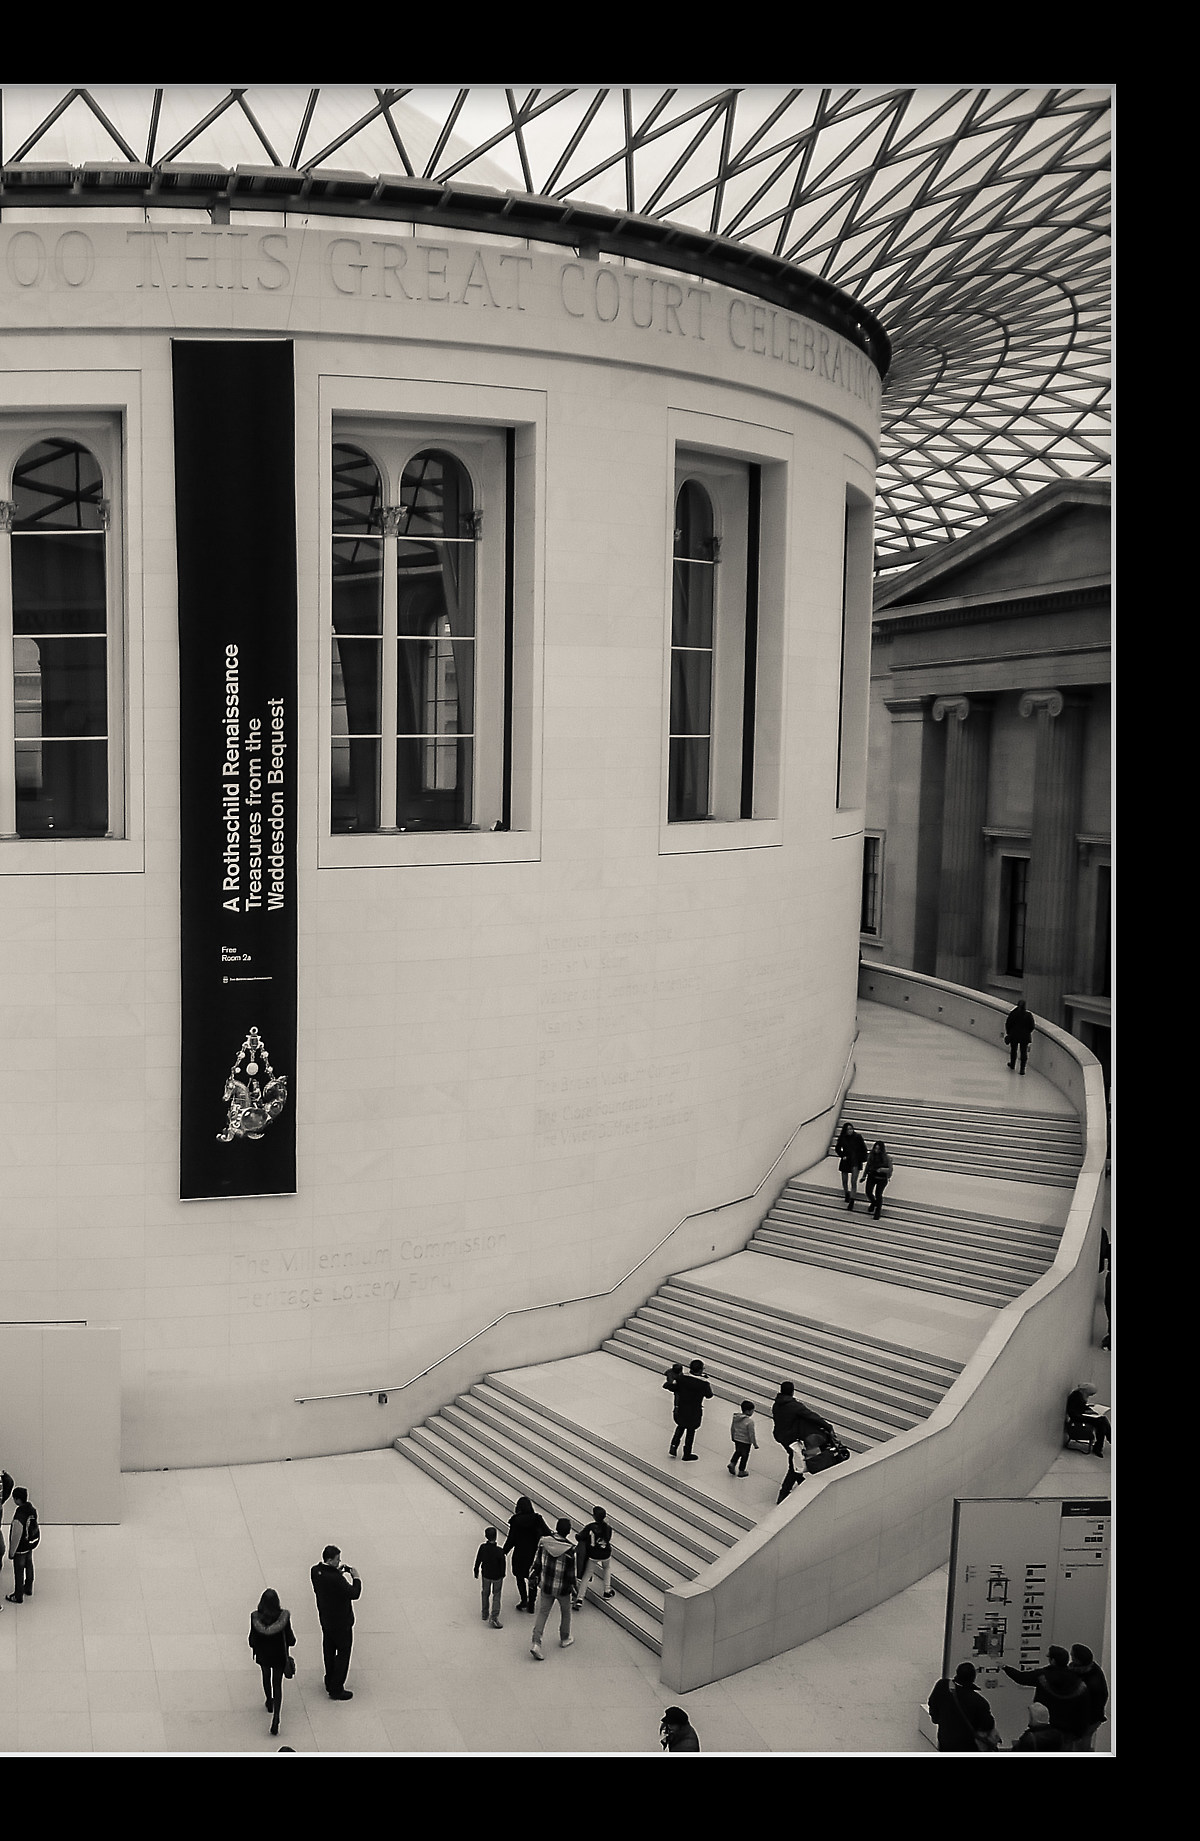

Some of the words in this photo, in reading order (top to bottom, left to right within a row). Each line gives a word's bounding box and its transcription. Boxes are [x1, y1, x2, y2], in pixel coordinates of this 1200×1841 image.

[126, 230, 291, 290] THIS
[326, 237, 533, 311] GREAT
[560, 263, 711, 341] COURT
[221, 643, 240, 776] Renaissance
[244, 718, 262, 752] the
[267, 697, 287, 784] Bequest
[244, 758, 262, 807] from
[222, 783, 240, 891] Rothschild
[245, 811, 262, 912] Treasures
[267, 791, 285, 911] Waddesdon
[222, 896, 240, 913] A
[221, 945, 237, 954] Free
[221, 954, 241, 962] Room
